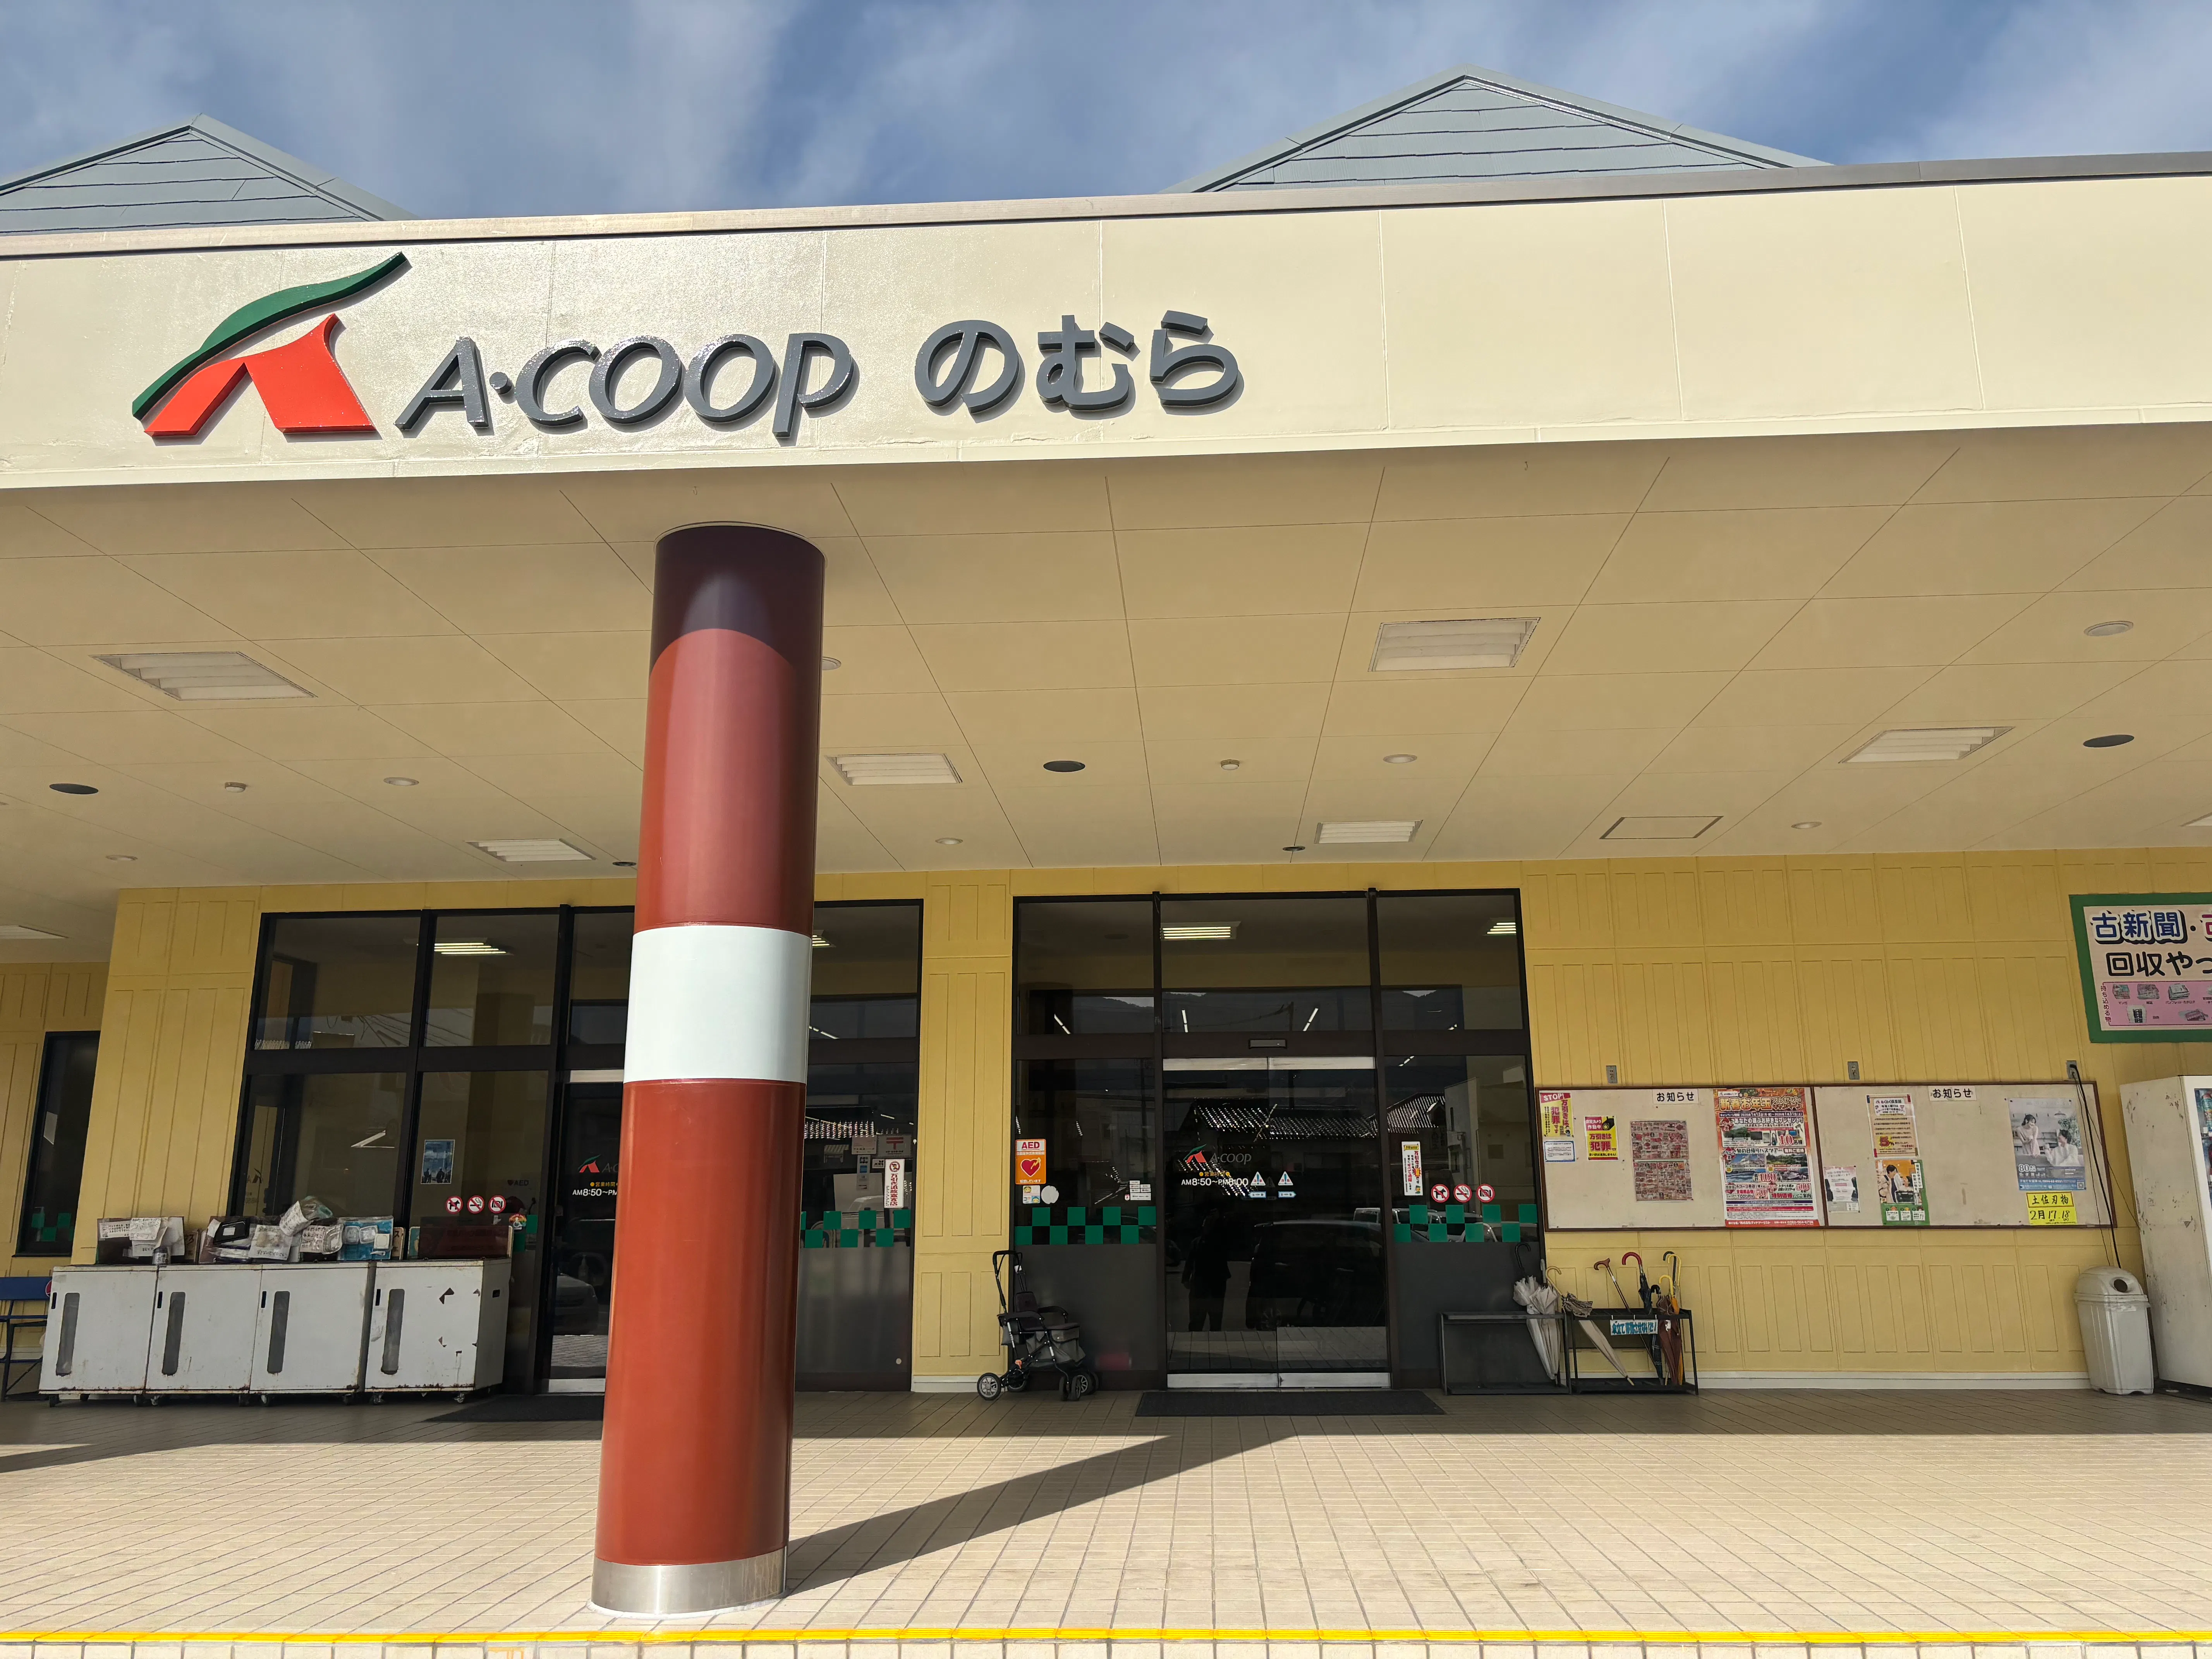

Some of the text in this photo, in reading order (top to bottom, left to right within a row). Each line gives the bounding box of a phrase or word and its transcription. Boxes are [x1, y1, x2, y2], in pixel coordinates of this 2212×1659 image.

[914, 310, 1240, 414] のむら
[1656, 1091, 1694, 1102] お知らせ
[1932, 1088, 1972, 1098] お知らせ
[1719, 1097, 1772, 1111] 新春お年玉
[2032, 1194, 2068, 1205] 土佐刃物
